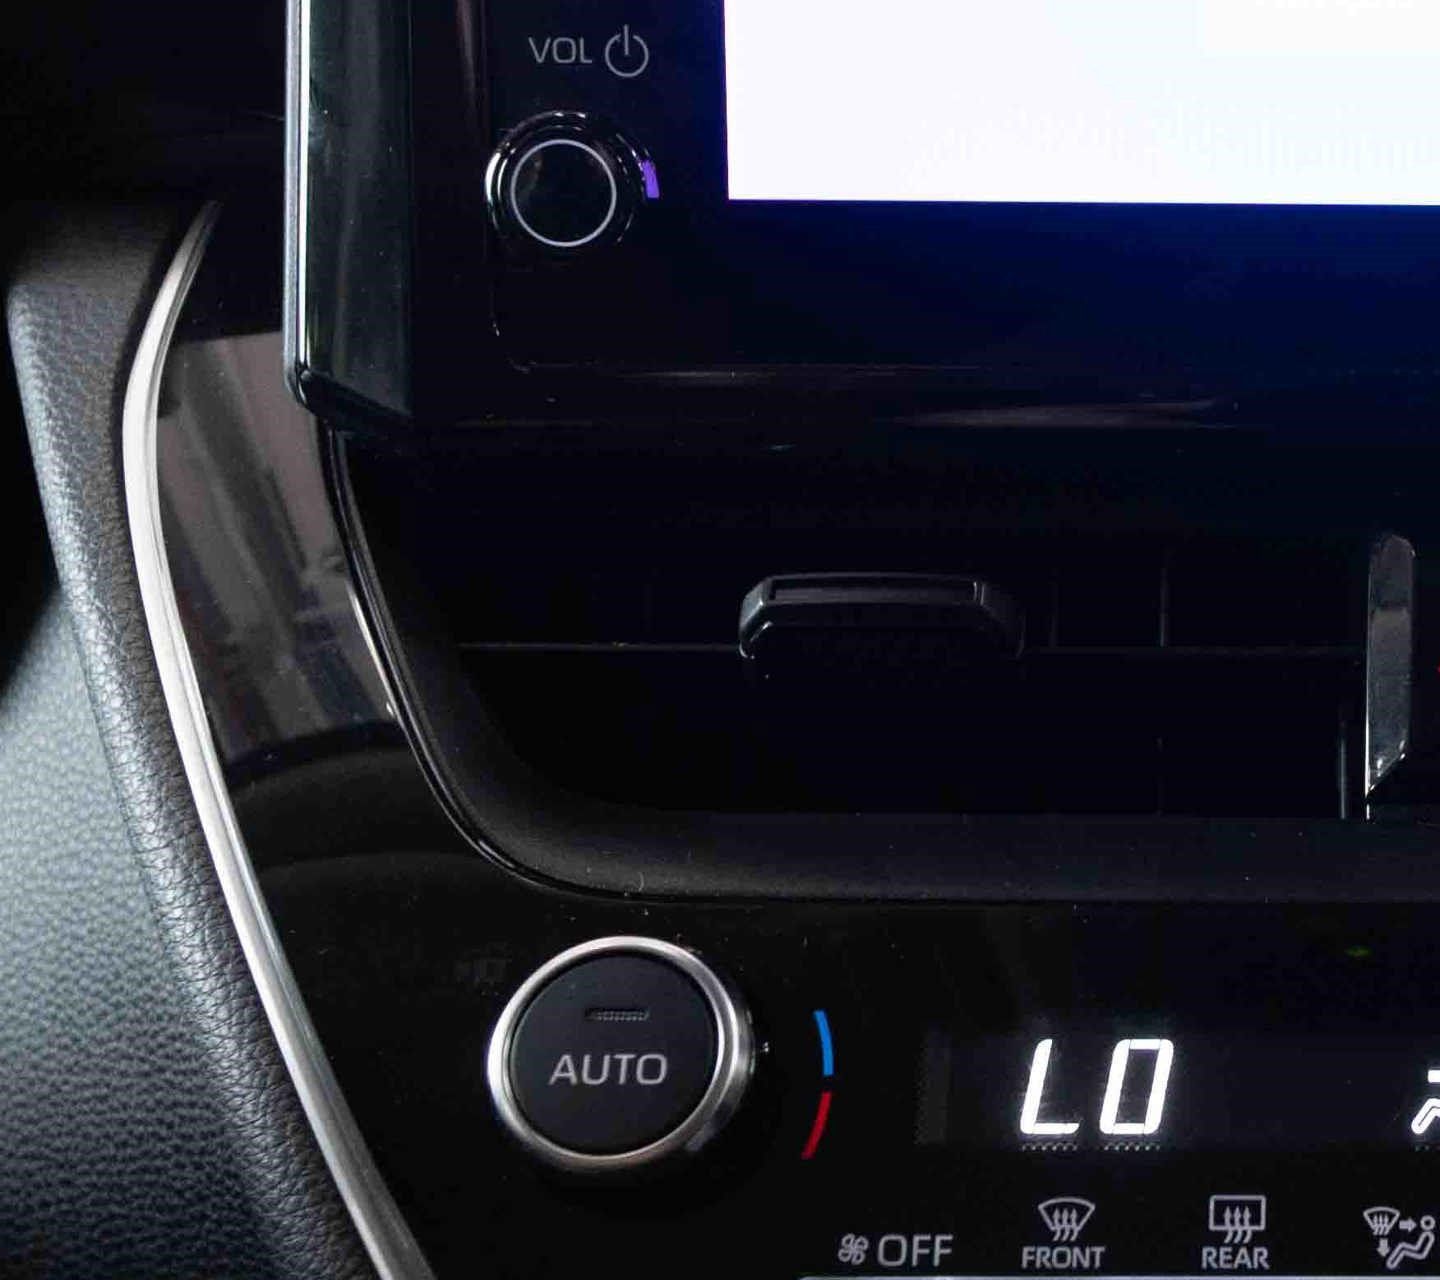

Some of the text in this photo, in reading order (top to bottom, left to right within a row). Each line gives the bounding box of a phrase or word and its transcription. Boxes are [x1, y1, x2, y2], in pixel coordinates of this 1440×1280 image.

[527, 36, 592, 64] VOL
[548, 1052, 669, 1087] AUTO
[1019, 1037, 1175, 1135] LO
[877, 1234, 954, 1268] OFF
[1020, 1245, 1107, 1270] FRONT
[1201, 1245, 1271, 1270] REAR
